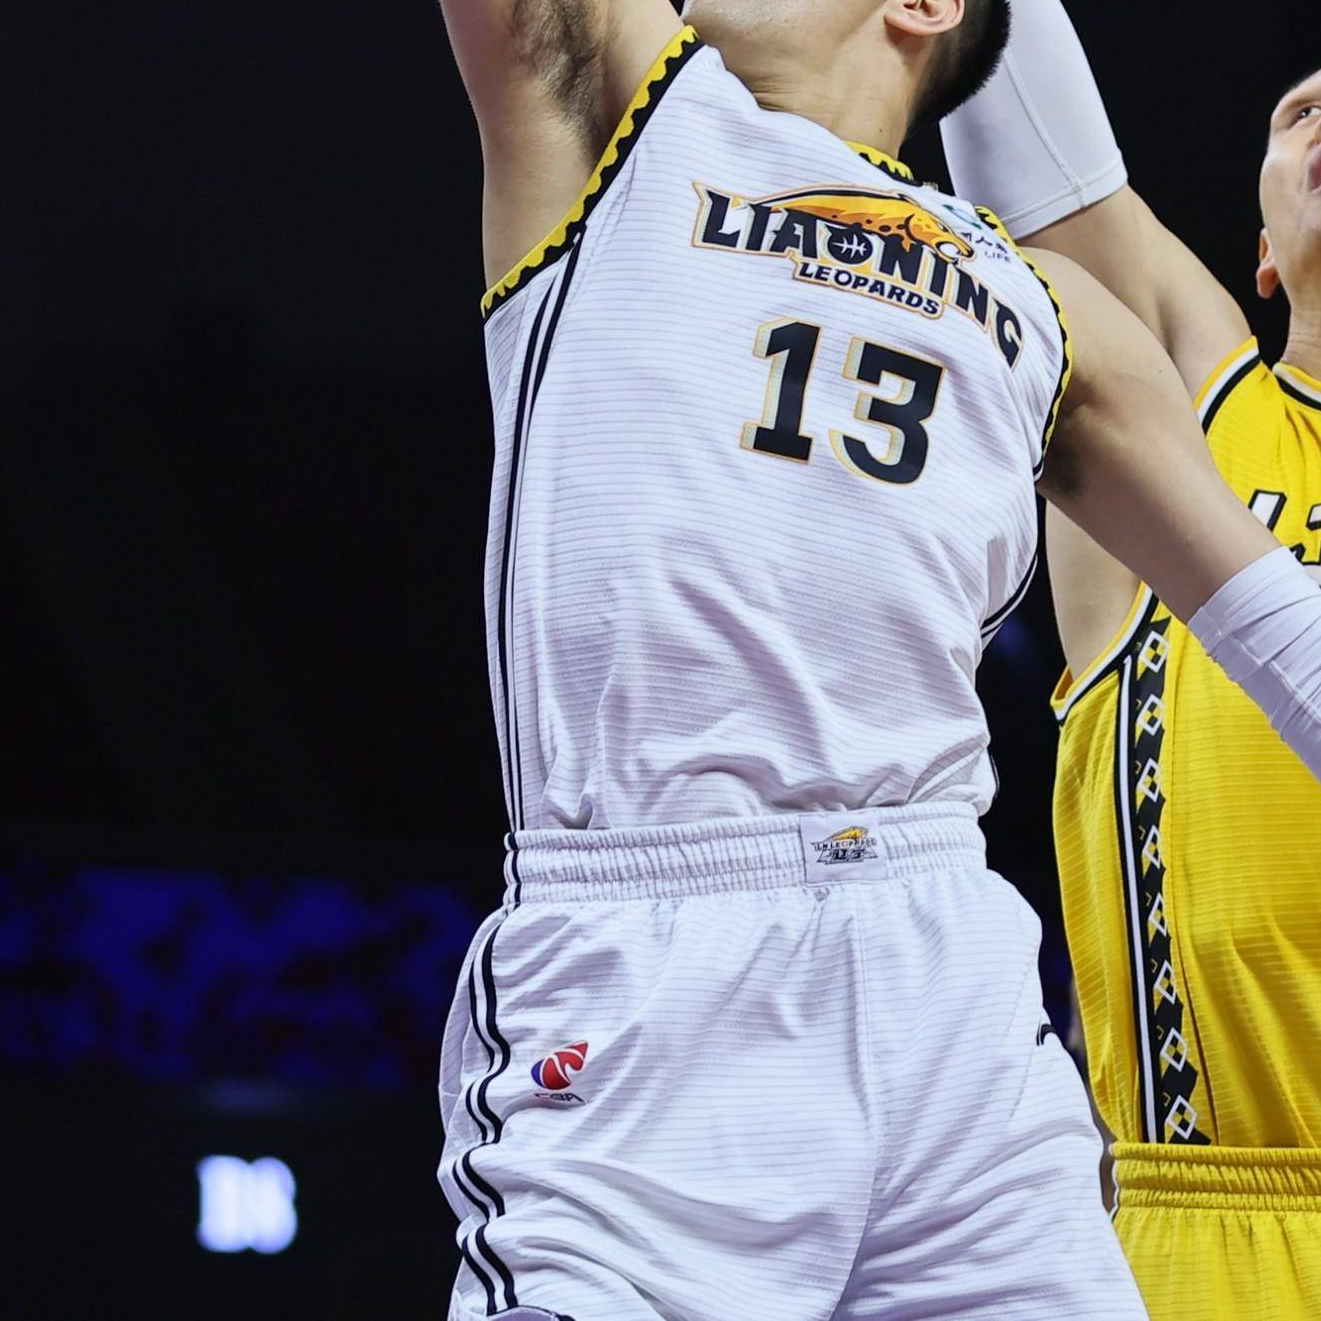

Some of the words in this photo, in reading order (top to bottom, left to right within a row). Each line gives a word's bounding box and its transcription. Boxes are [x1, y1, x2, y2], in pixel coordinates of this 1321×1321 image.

[691, 183, 1024, 372] LIAONING
[795, 260, 943, 319] LEOPARDS
[739, 318, 948, 486] 13
